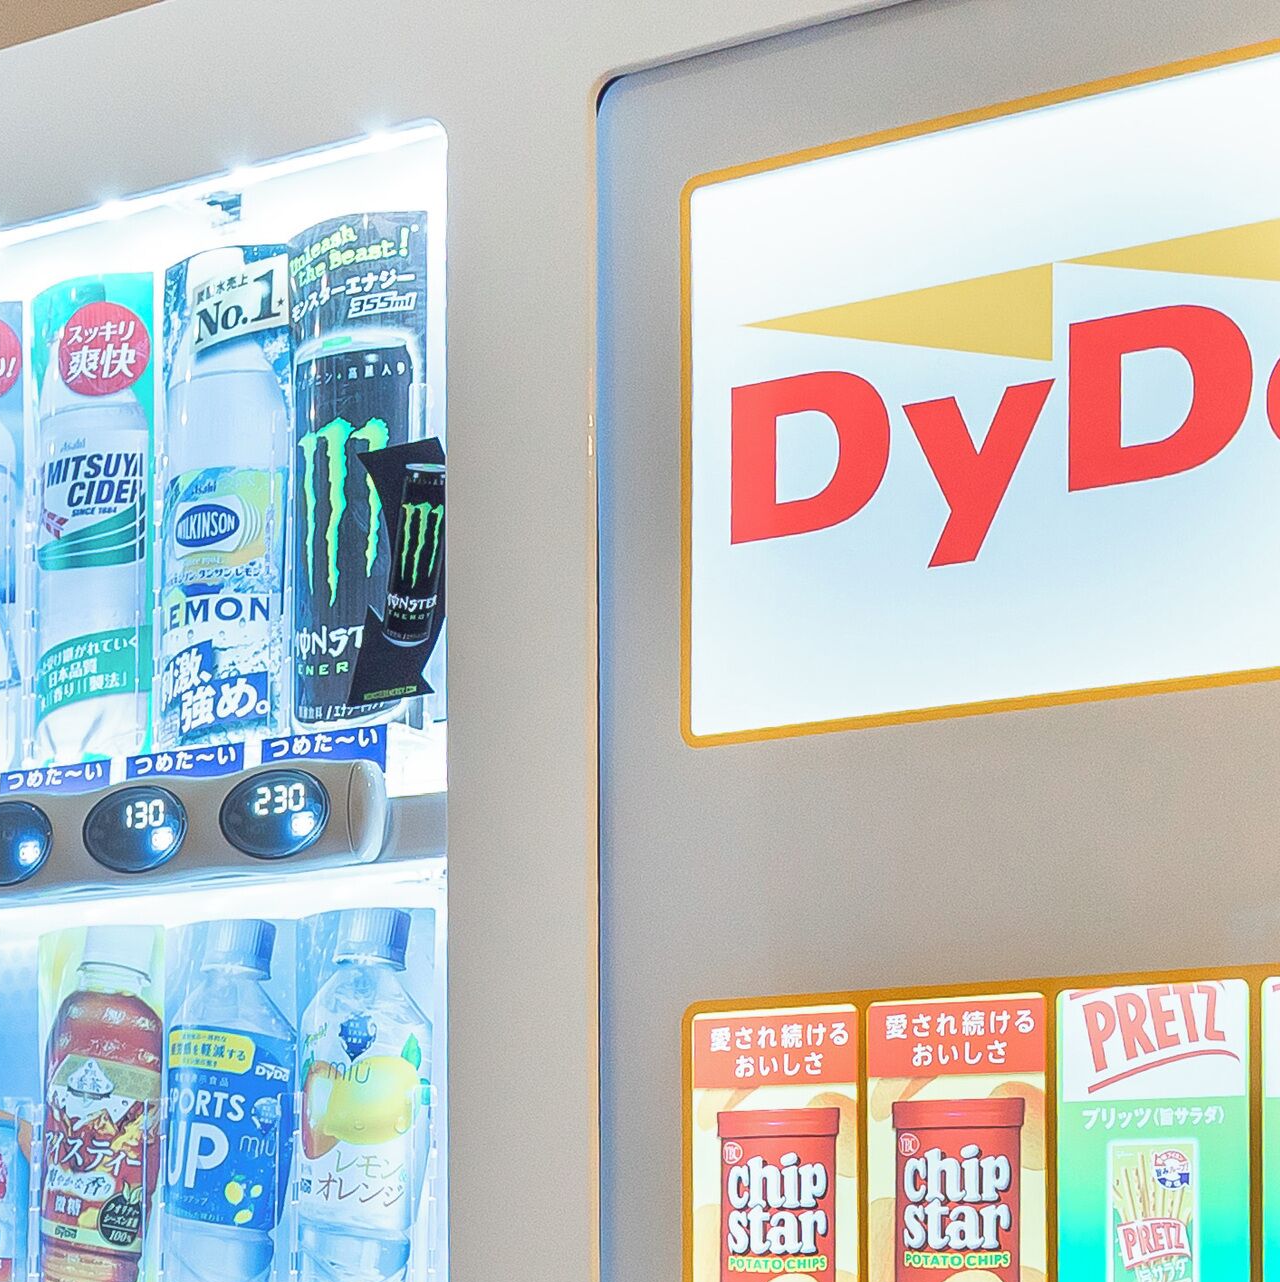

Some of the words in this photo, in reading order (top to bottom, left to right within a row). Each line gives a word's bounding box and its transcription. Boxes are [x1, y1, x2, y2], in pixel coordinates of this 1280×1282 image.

[194, 269, 281, 345] No.1
[66, 320, 136, 346] スッキリ
[66, 342, 137, 384] 爽快
[179, 677, 271, 734] 強め。
[125, 798, 165, 830] 130
[254, 783, 306, 817] 230
[709, 1021, 850, 1053] 愛され続ける
[884, 1008, 1036, 1041] 愛され続ける
[1081, 983, 1227, 1073] PRETZ
[254, 1061, 291, 1083] DyDo
[733, 1050, 825, 1080] おいしさ
[910, 1039, 1009, 1070] おいしさ
[167, 1117, 230, 1189] UP
[335, 1149, 404, 1180] レモン
[316, 1172, 404, 1208] オレンジ
[726, 1151, 828, 1211] chip
[902, 1143, 1012, 1204] chip
[726, 1202, 828, 1256] star
[902, 1197, 1012, 1251] star
[1122, 1221, 1185, 1261] PRETZ
[728, 1257, 783, 1272] POTATO
[784, 1255, 827, 1271] CHIPS
[904, 1252, 961, 1268] POTATO
[965, 1251, 1010, 1267] CHIPS
